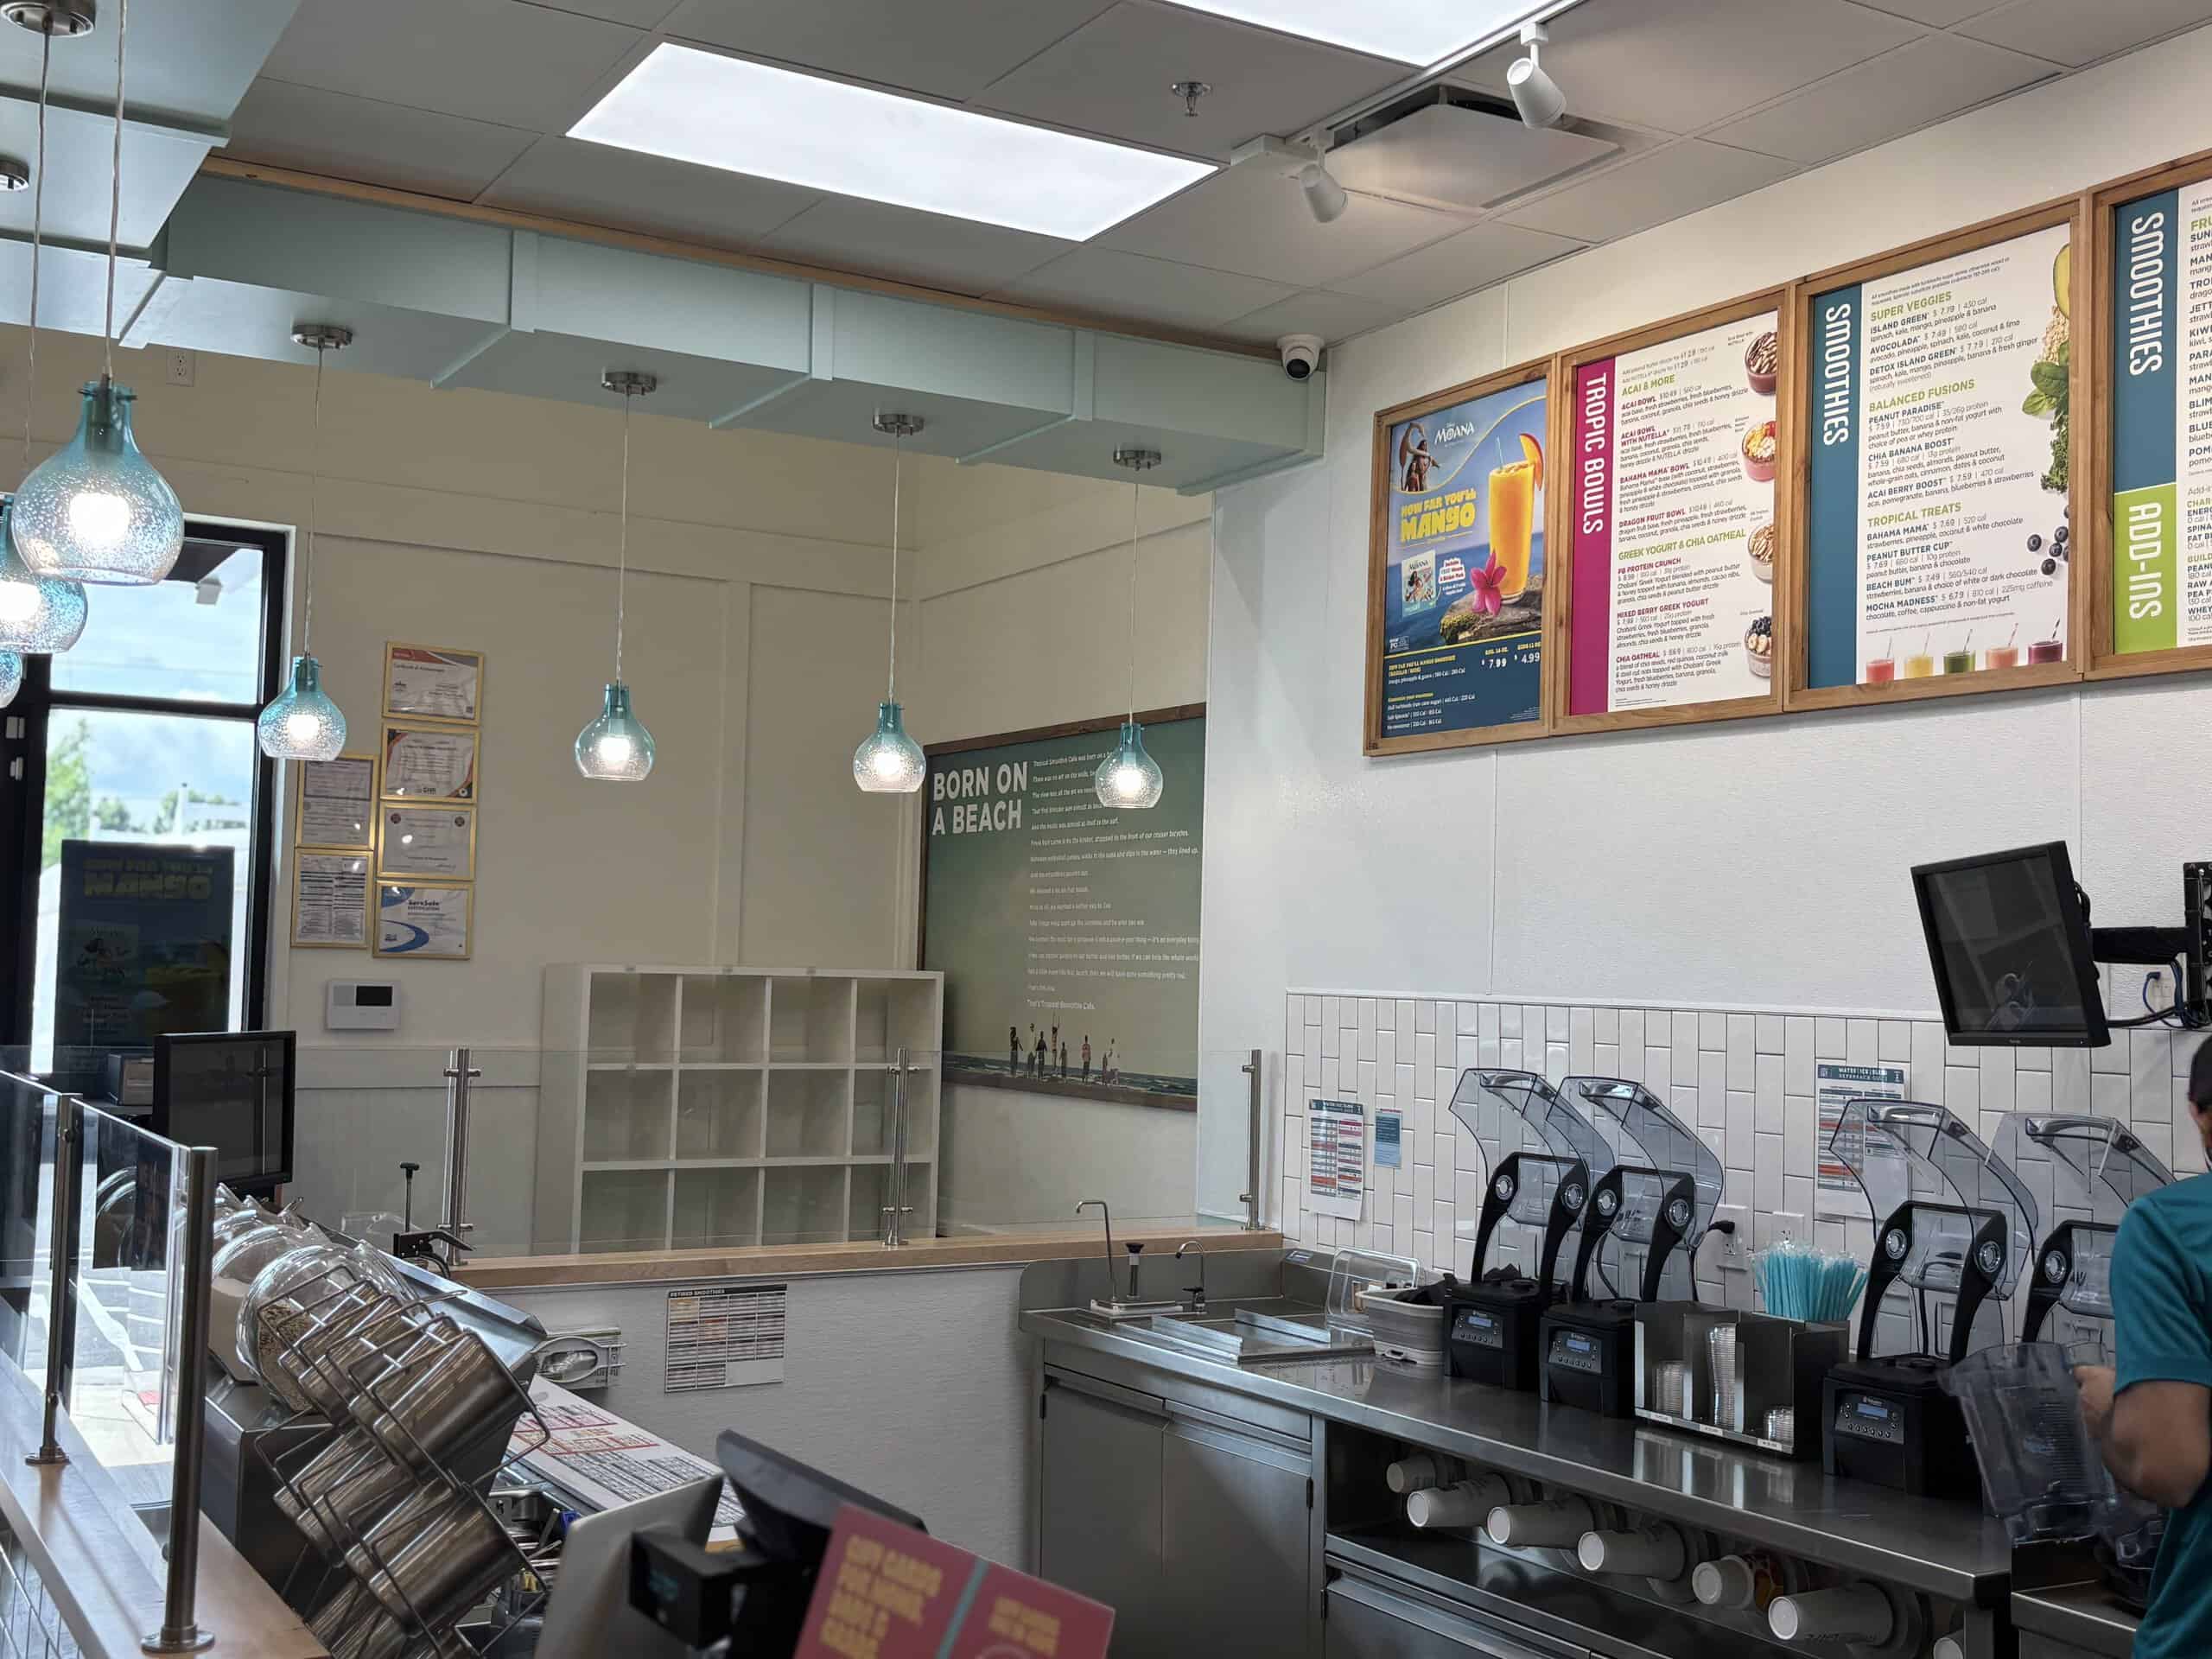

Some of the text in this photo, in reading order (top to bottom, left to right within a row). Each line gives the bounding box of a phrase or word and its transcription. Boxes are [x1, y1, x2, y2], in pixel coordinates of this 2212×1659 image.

[2129, 212, 2164, 376] SMOOTHIES
[1871, 291, 1951, 321] SUPER VEGGIES
[1870, 321, 1898, 334] ISLAND
[1823, 303, 1851, 446] SMOOTHIES
[1870, 363, 1894, 375] DETOX
[1897, 355, 1926, 368] ISLAND
[1622, 383, 1641, 396] ACAI
[1650, 374, 1674, 388] MORE
[1869, 379, 1974, 411] BALANCED FUSIONS
[1621, 396, 1656, 410] ACAI BOWL
[1868, 430, 1889, 442] peanut
[1891, 426, 1910, 436] butter,
[1911, 421, 1933, 431] banana
[1941, 414, 1963, 425] non-fat
[1965, 410, 1986, 422] yogurt
[1988, 406, 2001, 415] with
[1869, 411, 1899, 423] PEANUT
[1434, 419, 1474, 444] MOANA
[1621, 425, 1655, 439] ACAI BOWL
[1868, 439, 1887, 449] choice
[1897, 436, 1908, 445] pea
[1917, 429, 1933, 440] whey
[1935, 424, 1956, 436] protein
[1621, 437, 1636, 447] WITH
[1868, 451, 1886, 461] CHIA
[1889, 443, 1922, 457] BANANA
[1582, 372, 1607, 535] TROPIC BOWLS
[1620, 472, 1646, 483] BAHAMA
[1669, 462, 1688, 472] BOWL
[1867, 489, 1885, 499] ACAI
[1888, 484, 1912, 494] BERRY
[1401, 500, 1475, 543] MANGO
[1618, 508, 1685, 527] DRAGON FRUIT BOWL
[1867, 502, 1961, 527] TROPICAL TREATS
[1866, 537, 1904, 550] strawberries,
[1905, 531, 1937, 543] pineapple,
[1939, 527, 1964, 537] coconut
[1972, 522, 1989, 531] white
[1991, 517, 2023, 528] chocolate
[1867, 528, 1900, 540] BAHAMA
[1618, 548, 1643, 560] GREEK
[1645, 542, 1677, 555] YOGURT
[1686, 537, 1704, 548] CHIA
[1707, 529, 1745, 543] OATMEAL
[1866, 550, 1897, 562] PEANUT
[1900, 544, 1930, 556] BUTTER
[1627, 563, 1653, 572] PROTEIN
[1655, 557, 1681, 568] CRUNCH
[2128, 501, 2163, 620] ADD-INS
[1866, 588, 1902, 600] strawberries,
[1904, 584, 1926, 594] banana
[1934, 581, 1954, 589] choice
[1963, 576, 1980, 585] white
[2005, 569, 2037, 579] chocolate
[1866, 581, 1891, 590] BEACH
[2188, 580, 2207, 589] RAW
[2188, 590, 2203, 599] PEA
[1659, 603, 1680, 612] GREEK
[1682, 599, 1707, 608] YOGURT
[1866, 601, 1894, 612] MOCHA
[1866, 610, 1895, 620] chocolate,
[1897, 607, 1916, 616] coffee,
[1918, 602, 1955, 614] cappuccino
[1963, 598, 1986, 607] non-fat
[1987, 594, 2009, 605] yogurt
[1489, 657, 1506, 669] 7.99
[1521, 652, 1540, 664] 4.99
[1631, 652, 1659, 660] OATMEAL
[933, 766, 988, 801] BORN
[996, 761, 1027, 794] ON
[931, 806, 945, 836] A
[952, 798, 1021, 834] BEACH
